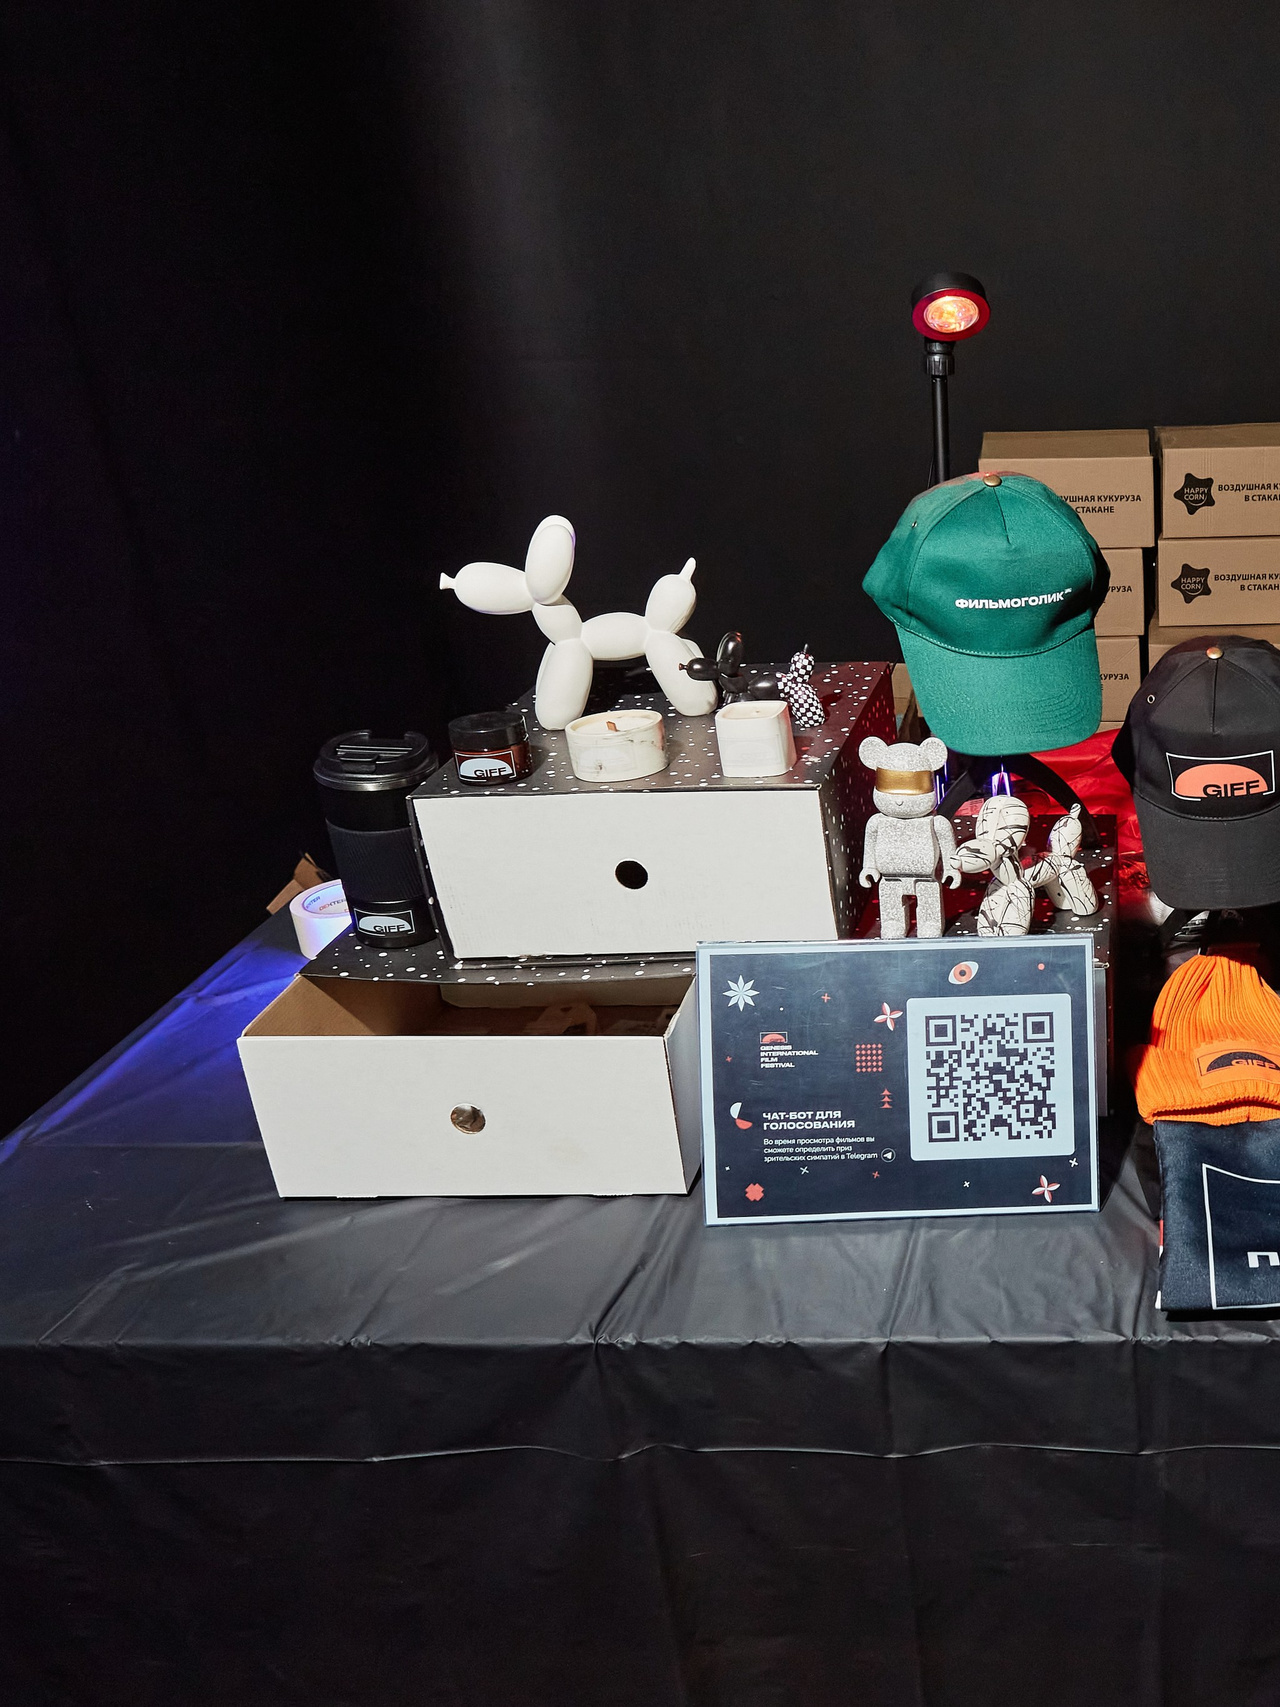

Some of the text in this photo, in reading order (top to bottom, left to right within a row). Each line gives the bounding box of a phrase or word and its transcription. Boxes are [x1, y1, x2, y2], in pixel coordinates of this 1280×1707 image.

[1218, 483, 1271, 491] ВОЗДУШНАЯ
[1098, 494, 1142, 502] КУКУРУЗА
[1214, 574, 1266, 582] ВОЗДУШНАЯ
[955, 592, 1064, 609] ФИЛЬМОГОЛИК
[474, 766, 507, 778] GIFF
[1203, 780, 1260, 797] GIFF
[374, 924, 406, 933] GIFF
[1231, 1058, 1276, 1070] GIFF
[762, 1110, 842, 1120] ЧАТ-БОТ ДЛЯ
[764, 1120, 856, 1130] ГОЛОСОВАНИЯ
[835, 1136, 864, 1144] фильмов
[795, 1146, 835, 1154] определить
[846, 1152, 878, 1160] Telegram
